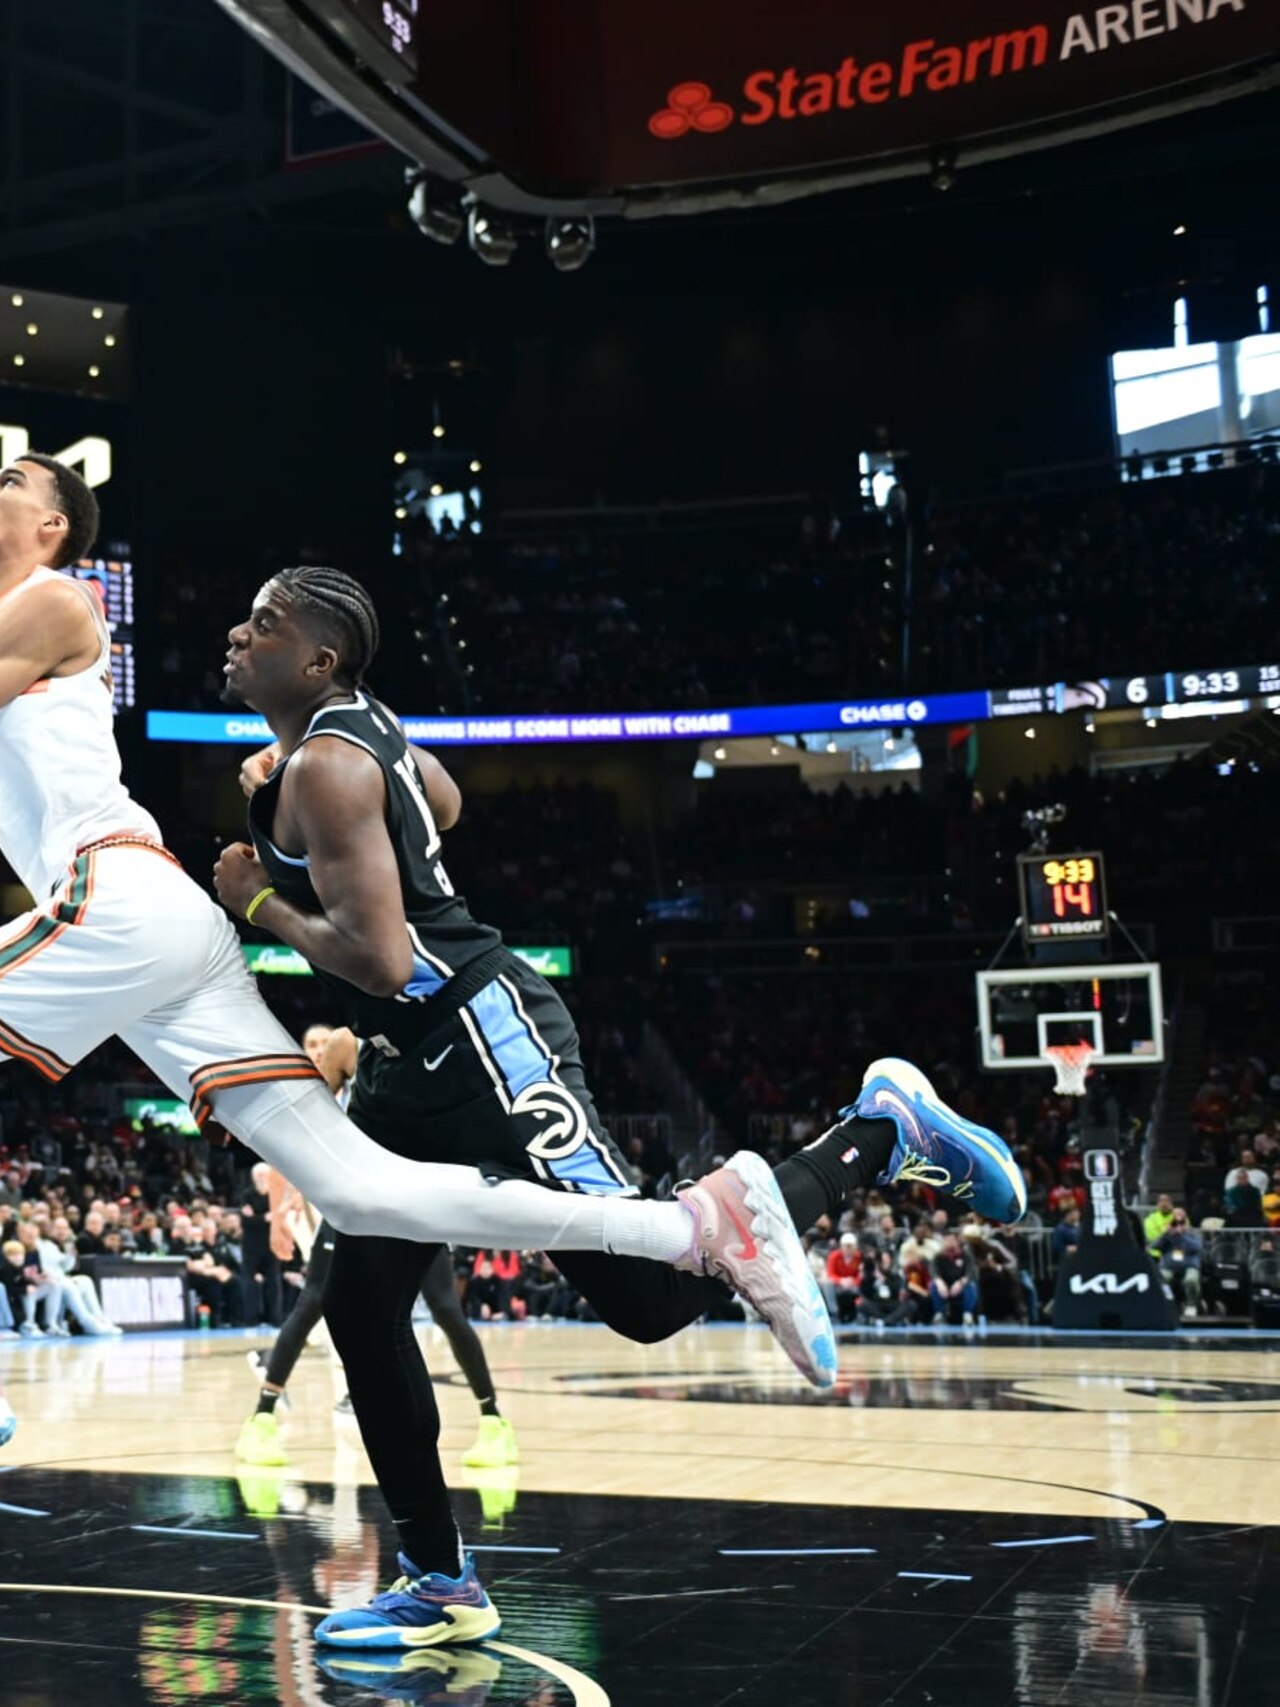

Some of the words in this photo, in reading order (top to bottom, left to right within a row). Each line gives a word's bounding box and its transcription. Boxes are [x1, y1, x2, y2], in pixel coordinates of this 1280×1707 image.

[1126, 677, 1148, 703] 6
[1182, 671, 1239, 696] 9:33
[515, 720, 569, 737] SCORE
[571, 718, 621, 736] MORE
[624, 717, 671, 734] WITH
[673, 713, 730, 733] CHASE
[839, 704, 907, 724] CHASE
[225, 721, 273, 737] CHAS
[1043, 858, 1094, 885] 9:33
[1053, 883, 1091, 917] 14
